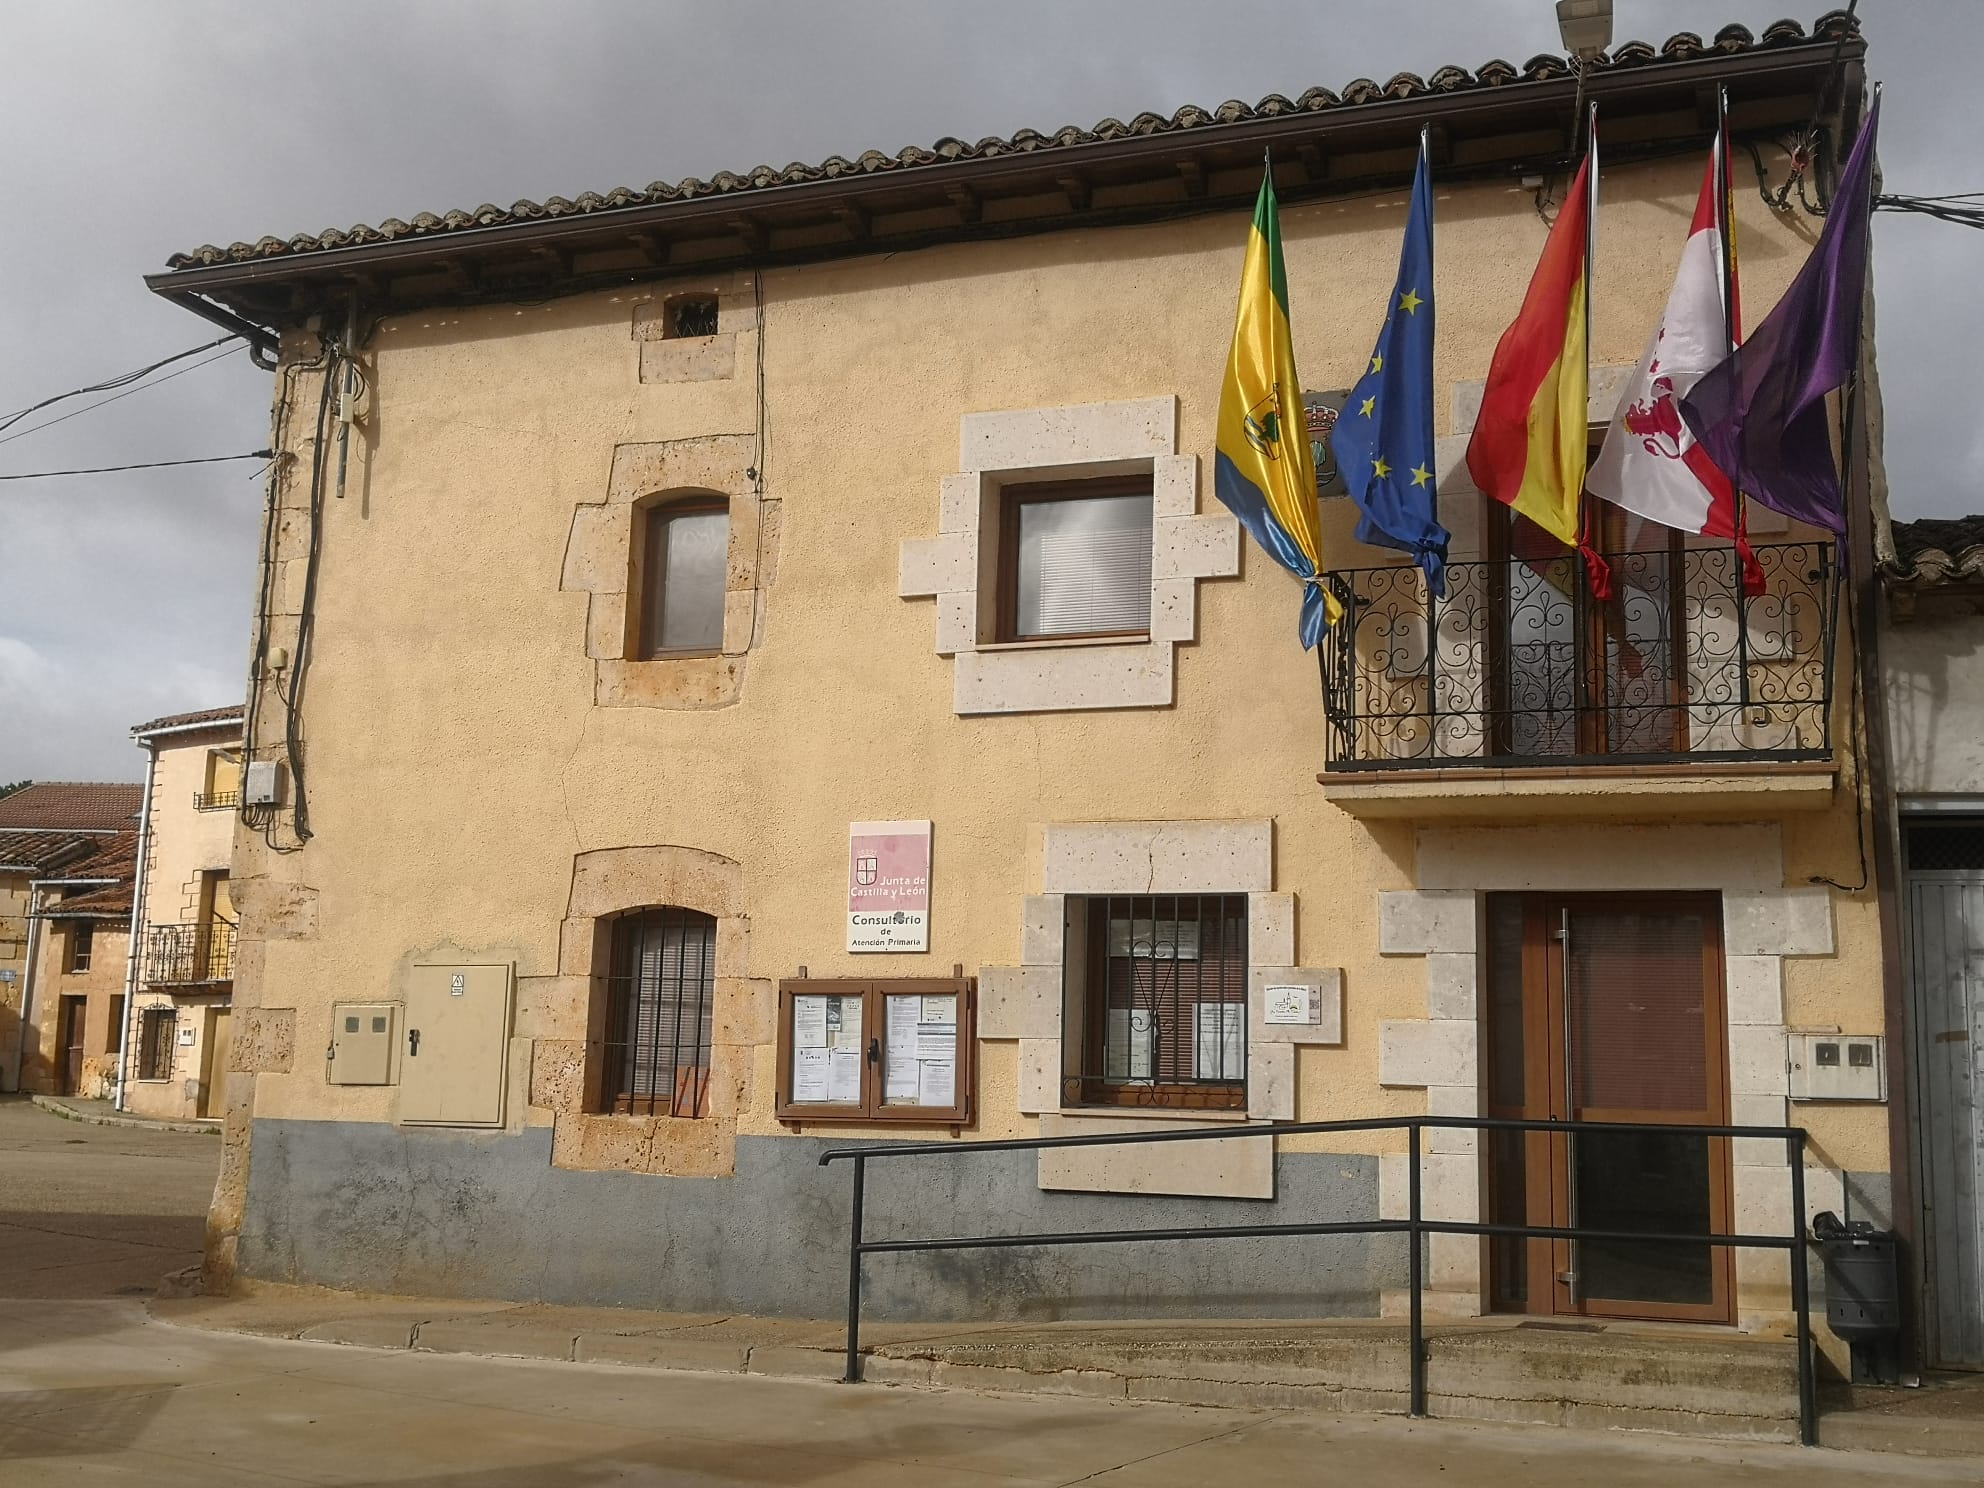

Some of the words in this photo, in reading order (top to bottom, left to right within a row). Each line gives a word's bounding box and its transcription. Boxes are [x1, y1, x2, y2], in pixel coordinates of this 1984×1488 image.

[880, 876, 910, 886] Junta
[914, 876, 926, 885] de
[850, 887, 889, 897] Castilla
[891, 889, 898, 899] y
[900, 886, 926, 896] León
[880, 928, 892, 936] de
[887, 938, 921, 946] Primaria
